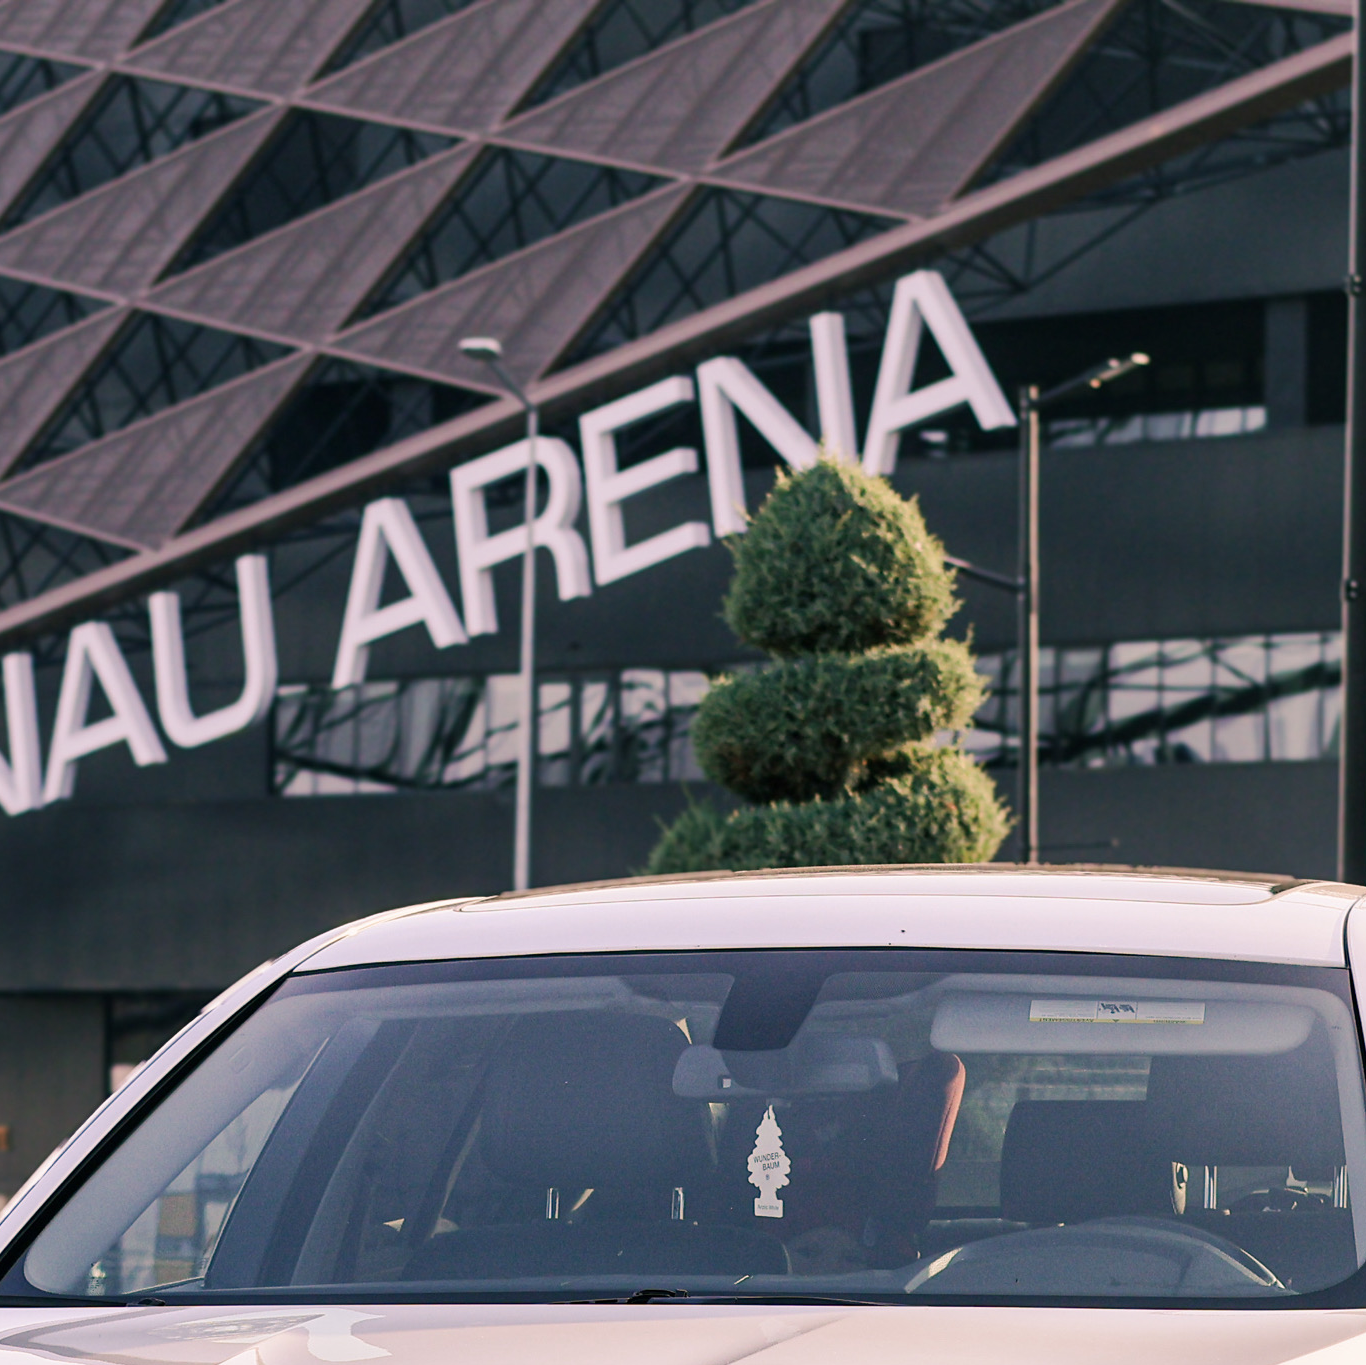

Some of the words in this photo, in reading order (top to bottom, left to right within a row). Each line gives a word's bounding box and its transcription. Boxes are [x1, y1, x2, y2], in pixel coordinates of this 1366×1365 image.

[331, 268, 1019, 691] ARENA
[753, 1152, 782, 1163] WUNDER-
[762, 1160, 780, 1171] BAUM
